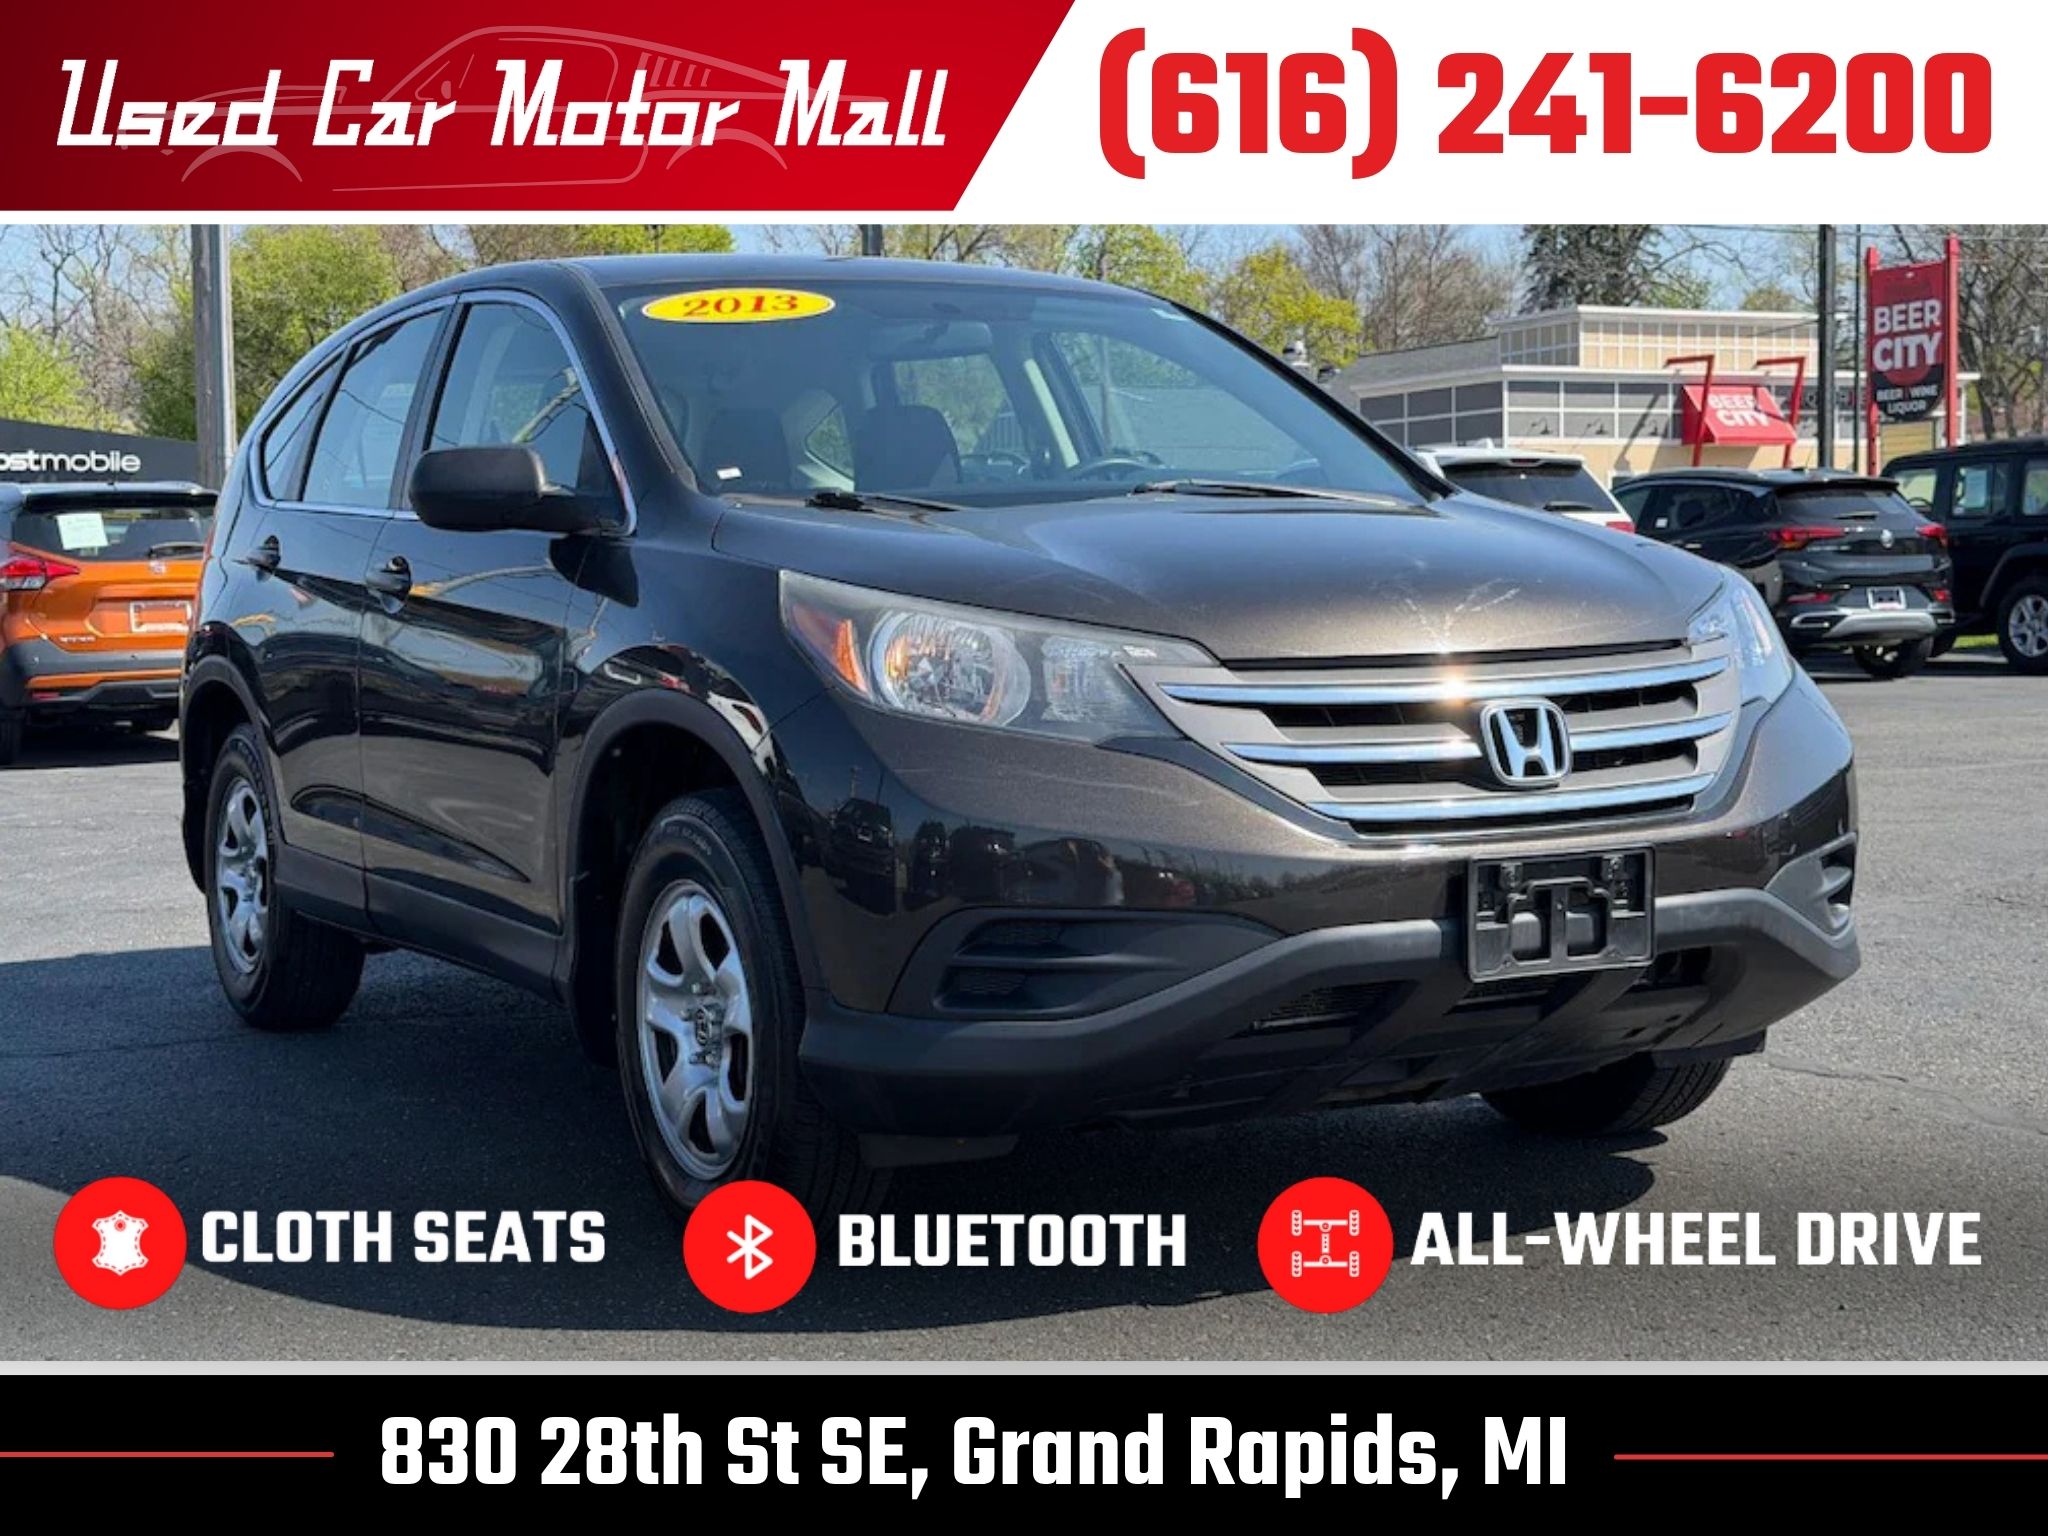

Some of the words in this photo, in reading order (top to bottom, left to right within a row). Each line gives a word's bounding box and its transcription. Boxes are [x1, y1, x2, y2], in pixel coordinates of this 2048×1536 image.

[683, 295, 798, 317] 2013
[1874, 299, 1941, 333] BEER
[1873, 334, 1942, 371] CITY
[1717, 410, 1770, 427] CITY
[1888, 401, 1927, 414] LIQUOR
